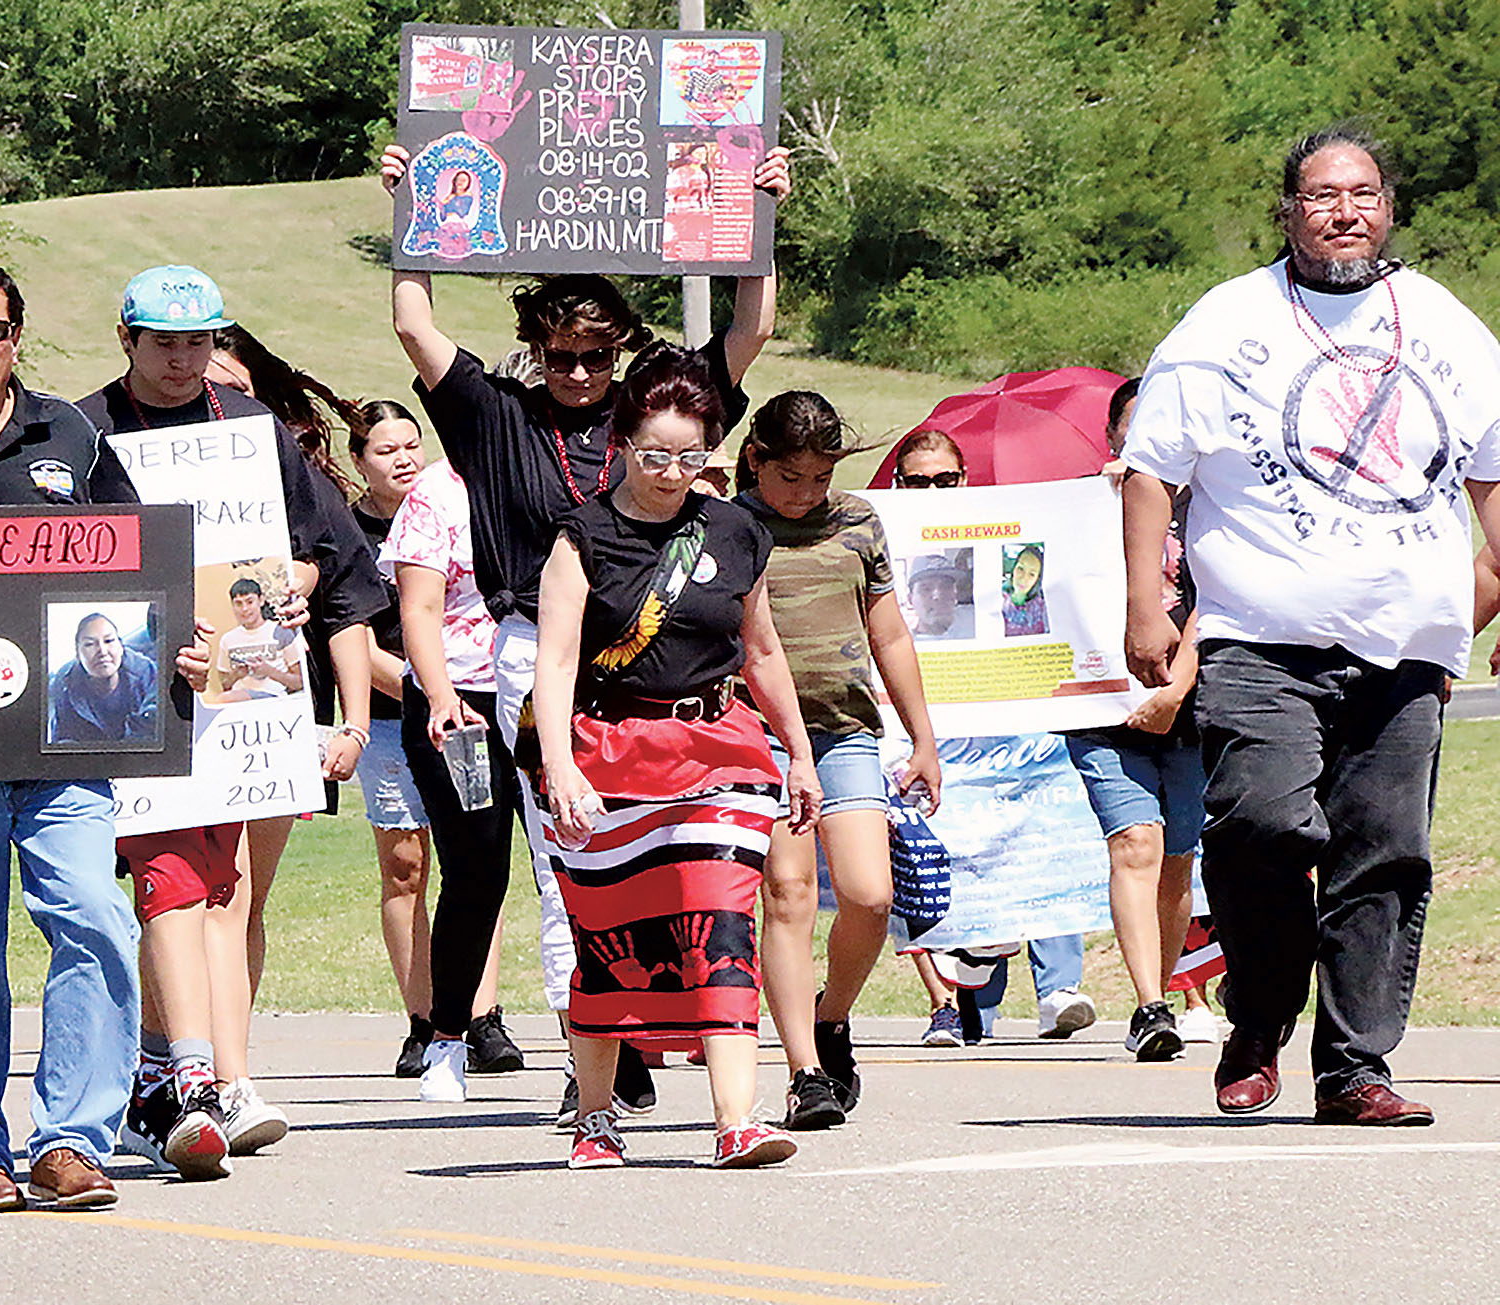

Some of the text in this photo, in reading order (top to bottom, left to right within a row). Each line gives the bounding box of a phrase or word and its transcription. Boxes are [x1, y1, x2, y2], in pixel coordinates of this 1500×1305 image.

[531, 35, 655, 66] KAYSERA
[553, 64, 646, 96] STOPS
[539, 88, 648, 118] PRETTY
[539, 117, 645, 148] PLACES
[539, 148, 651, 179] 08-14-02
[538, 186, 648, 217] 08-29-19
[176, 499, 277, 526] RAKE
[921, 524, 1021, 540] CASH REWARD
[218, 715, 302, 750] JULY
[242, 752, 269, 773] 21
[226, 779, 296, 806] 2021
